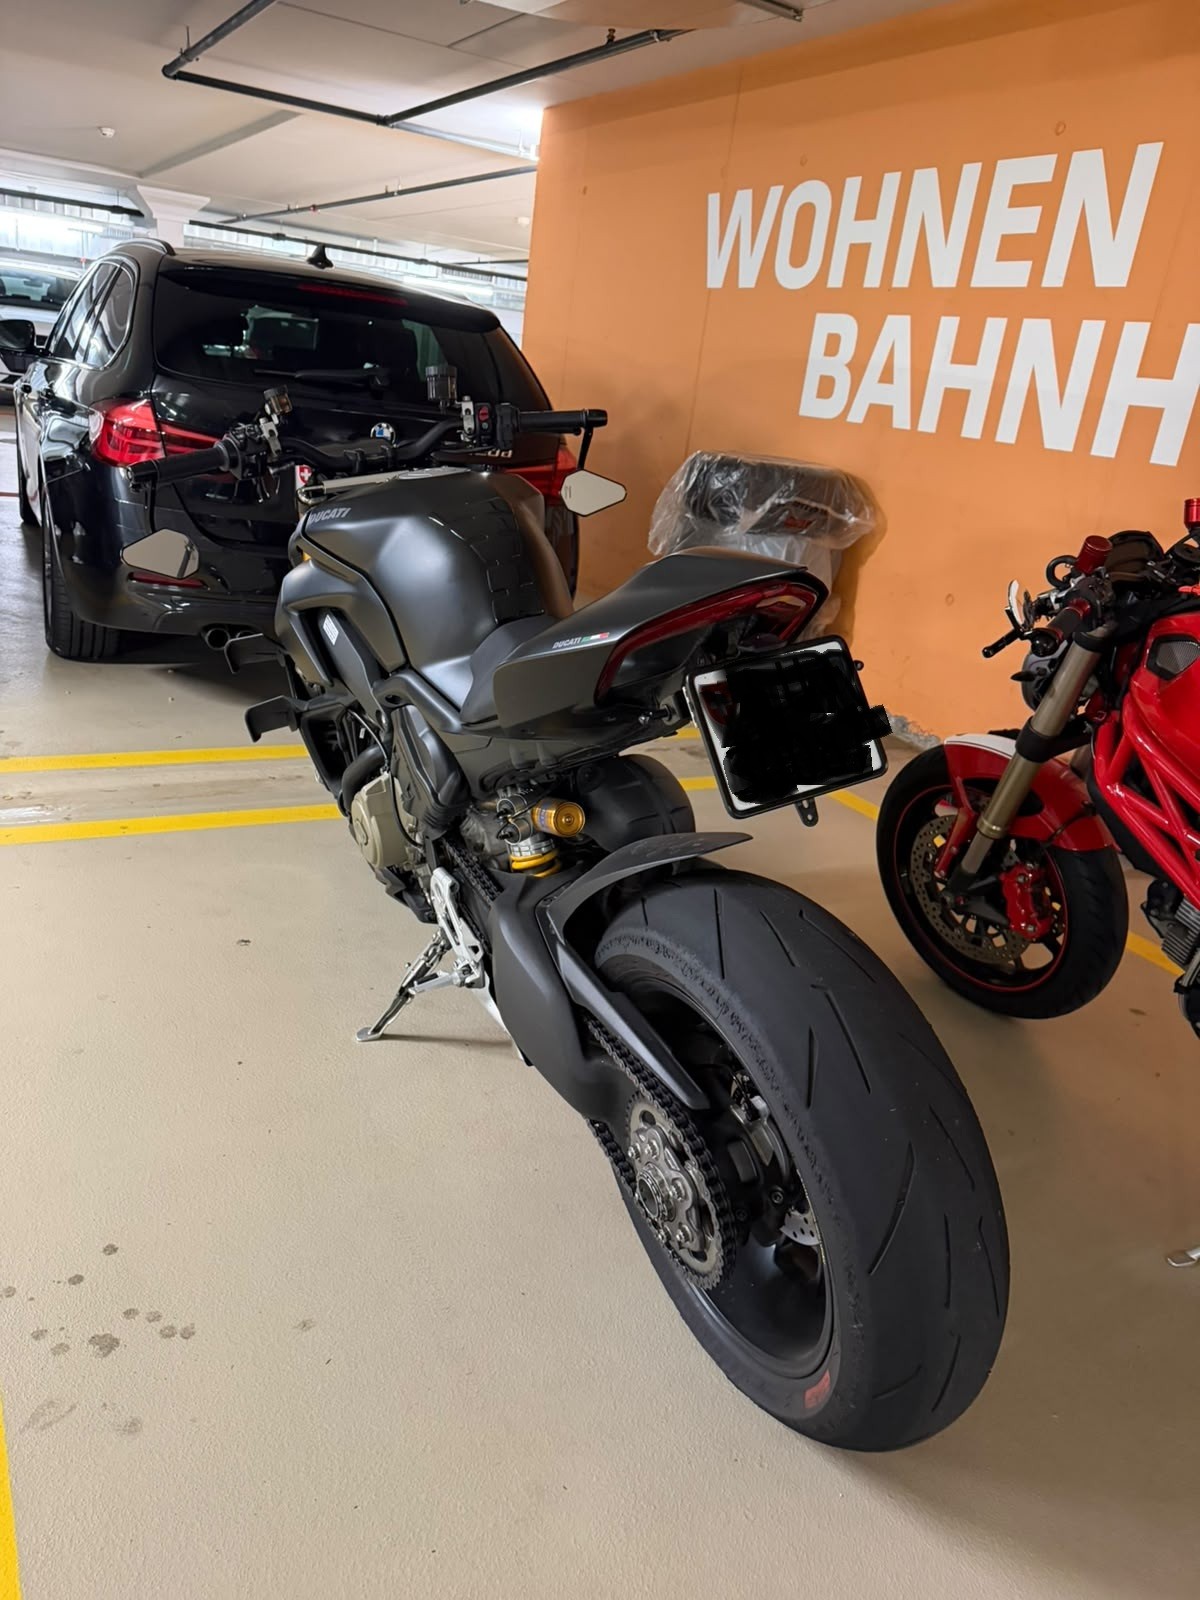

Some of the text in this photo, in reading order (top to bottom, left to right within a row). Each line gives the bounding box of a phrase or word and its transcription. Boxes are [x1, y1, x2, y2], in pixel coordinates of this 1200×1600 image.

[706, 141, 1164, 290] WOHNEN
[798, 313, 1200, 467] BAHNH
[307, 507, 351, 524] DUCATI
[552, 636, 582, 649] DUCATI
